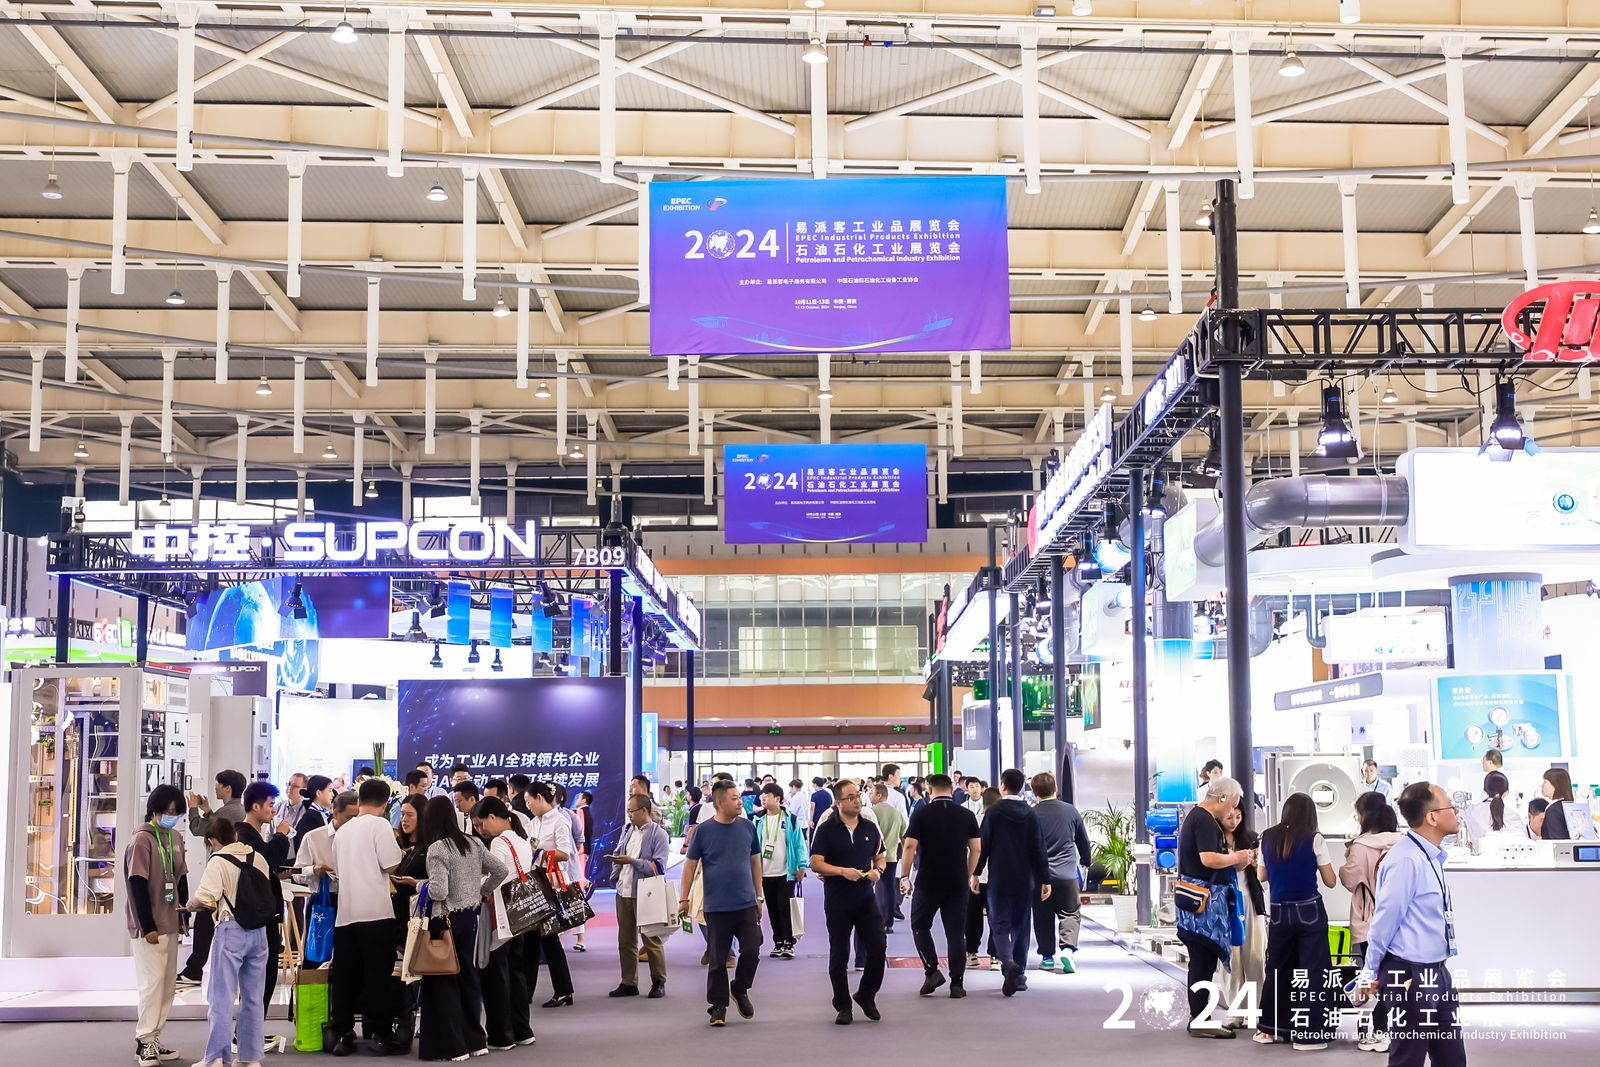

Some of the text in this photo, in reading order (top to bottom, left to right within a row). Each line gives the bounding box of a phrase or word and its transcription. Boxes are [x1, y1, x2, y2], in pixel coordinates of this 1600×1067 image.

[670, 197, 692, 205] EPEC
[796, 219, 960, 234] 易派客工业品展览会
[821, 233, 866, 241] Industrial
[796, 242, 960, 256] 石油石化工业展览会
[796, 256, 831, 264] Petroleum
[847, 255, 896, 263] Petrochemical
[897, 254, 925, 263] Industry
[572, 548, 625, 566] 7B09
[424, 752, 600, 769] 成为工业AI全球领先企业
